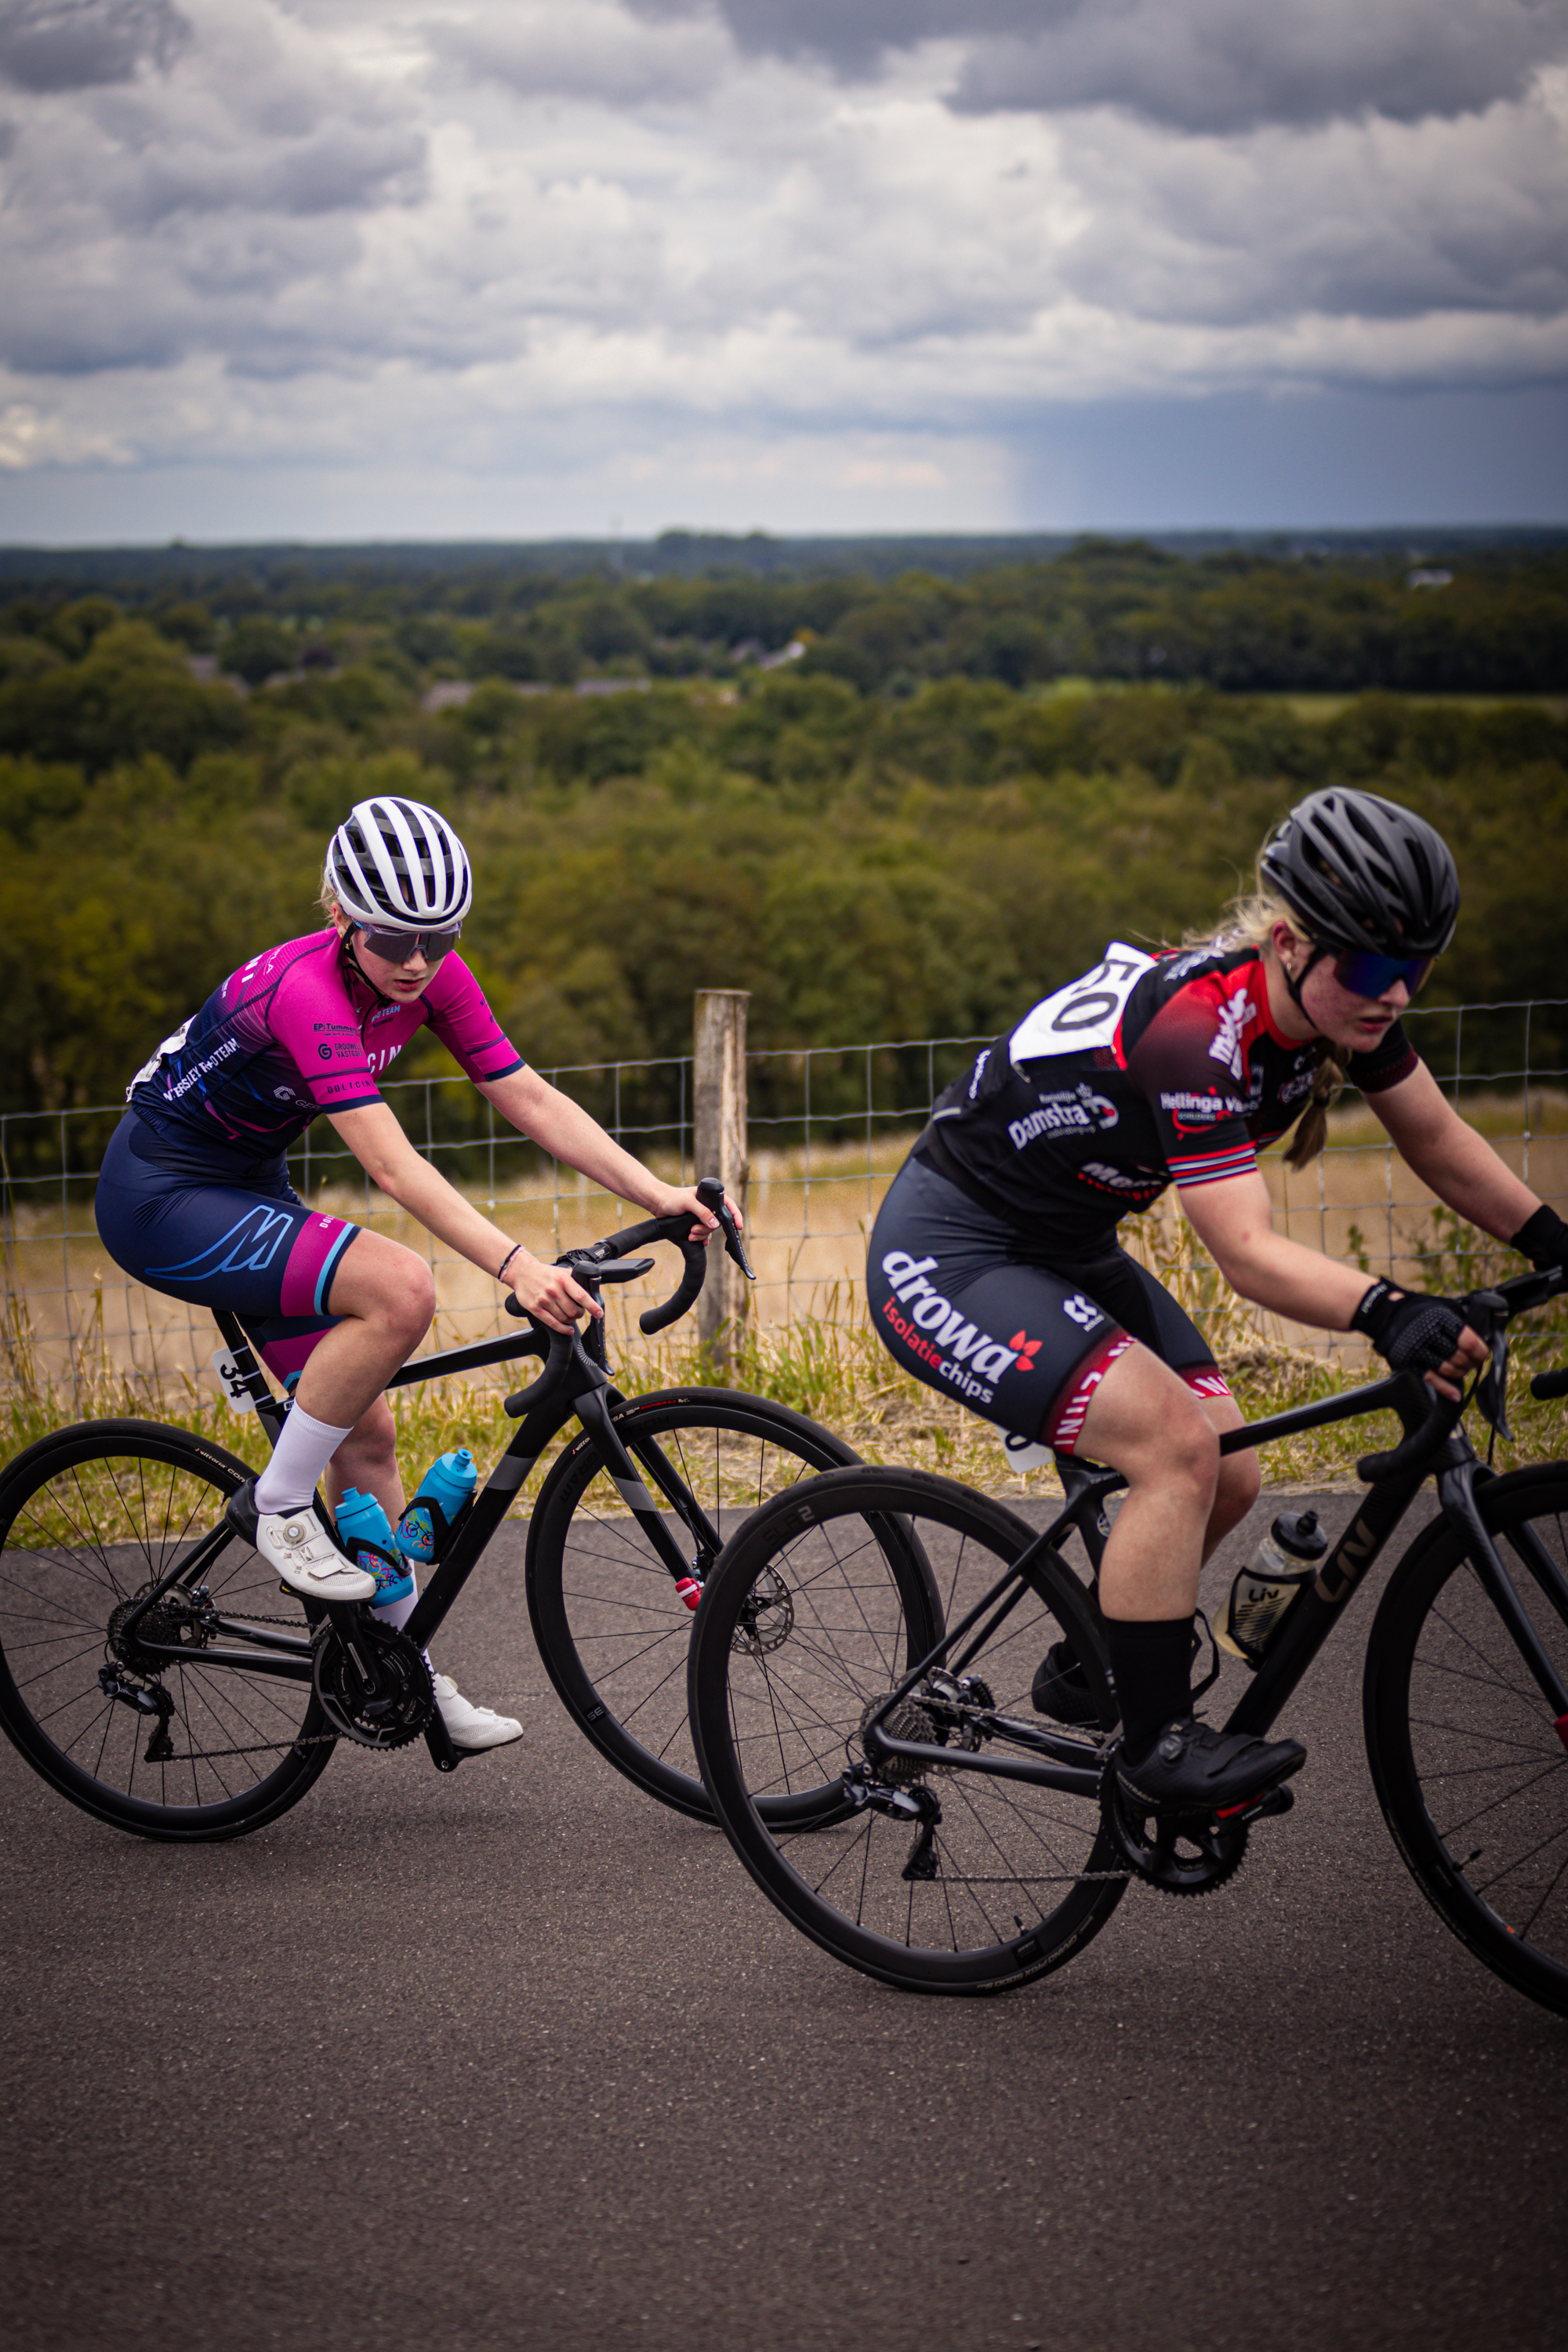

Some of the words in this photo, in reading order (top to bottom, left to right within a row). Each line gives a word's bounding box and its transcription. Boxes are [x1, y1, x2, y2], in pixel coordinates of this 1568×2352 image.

[382, 1005, 401, 1016] TEAM
[1051, 959, 1141, 1032] 50
[214, 1038, 240, 1062] TEAM
[1160, 1092, 1222, 1113] Hellinga
[1008, 1102, 1091, 1150] Damstra
[882, 1250, 1018, 1385] drowa
[220, 1363, 250, 1399] 34
[227, 1468, 245, 1483] COR
